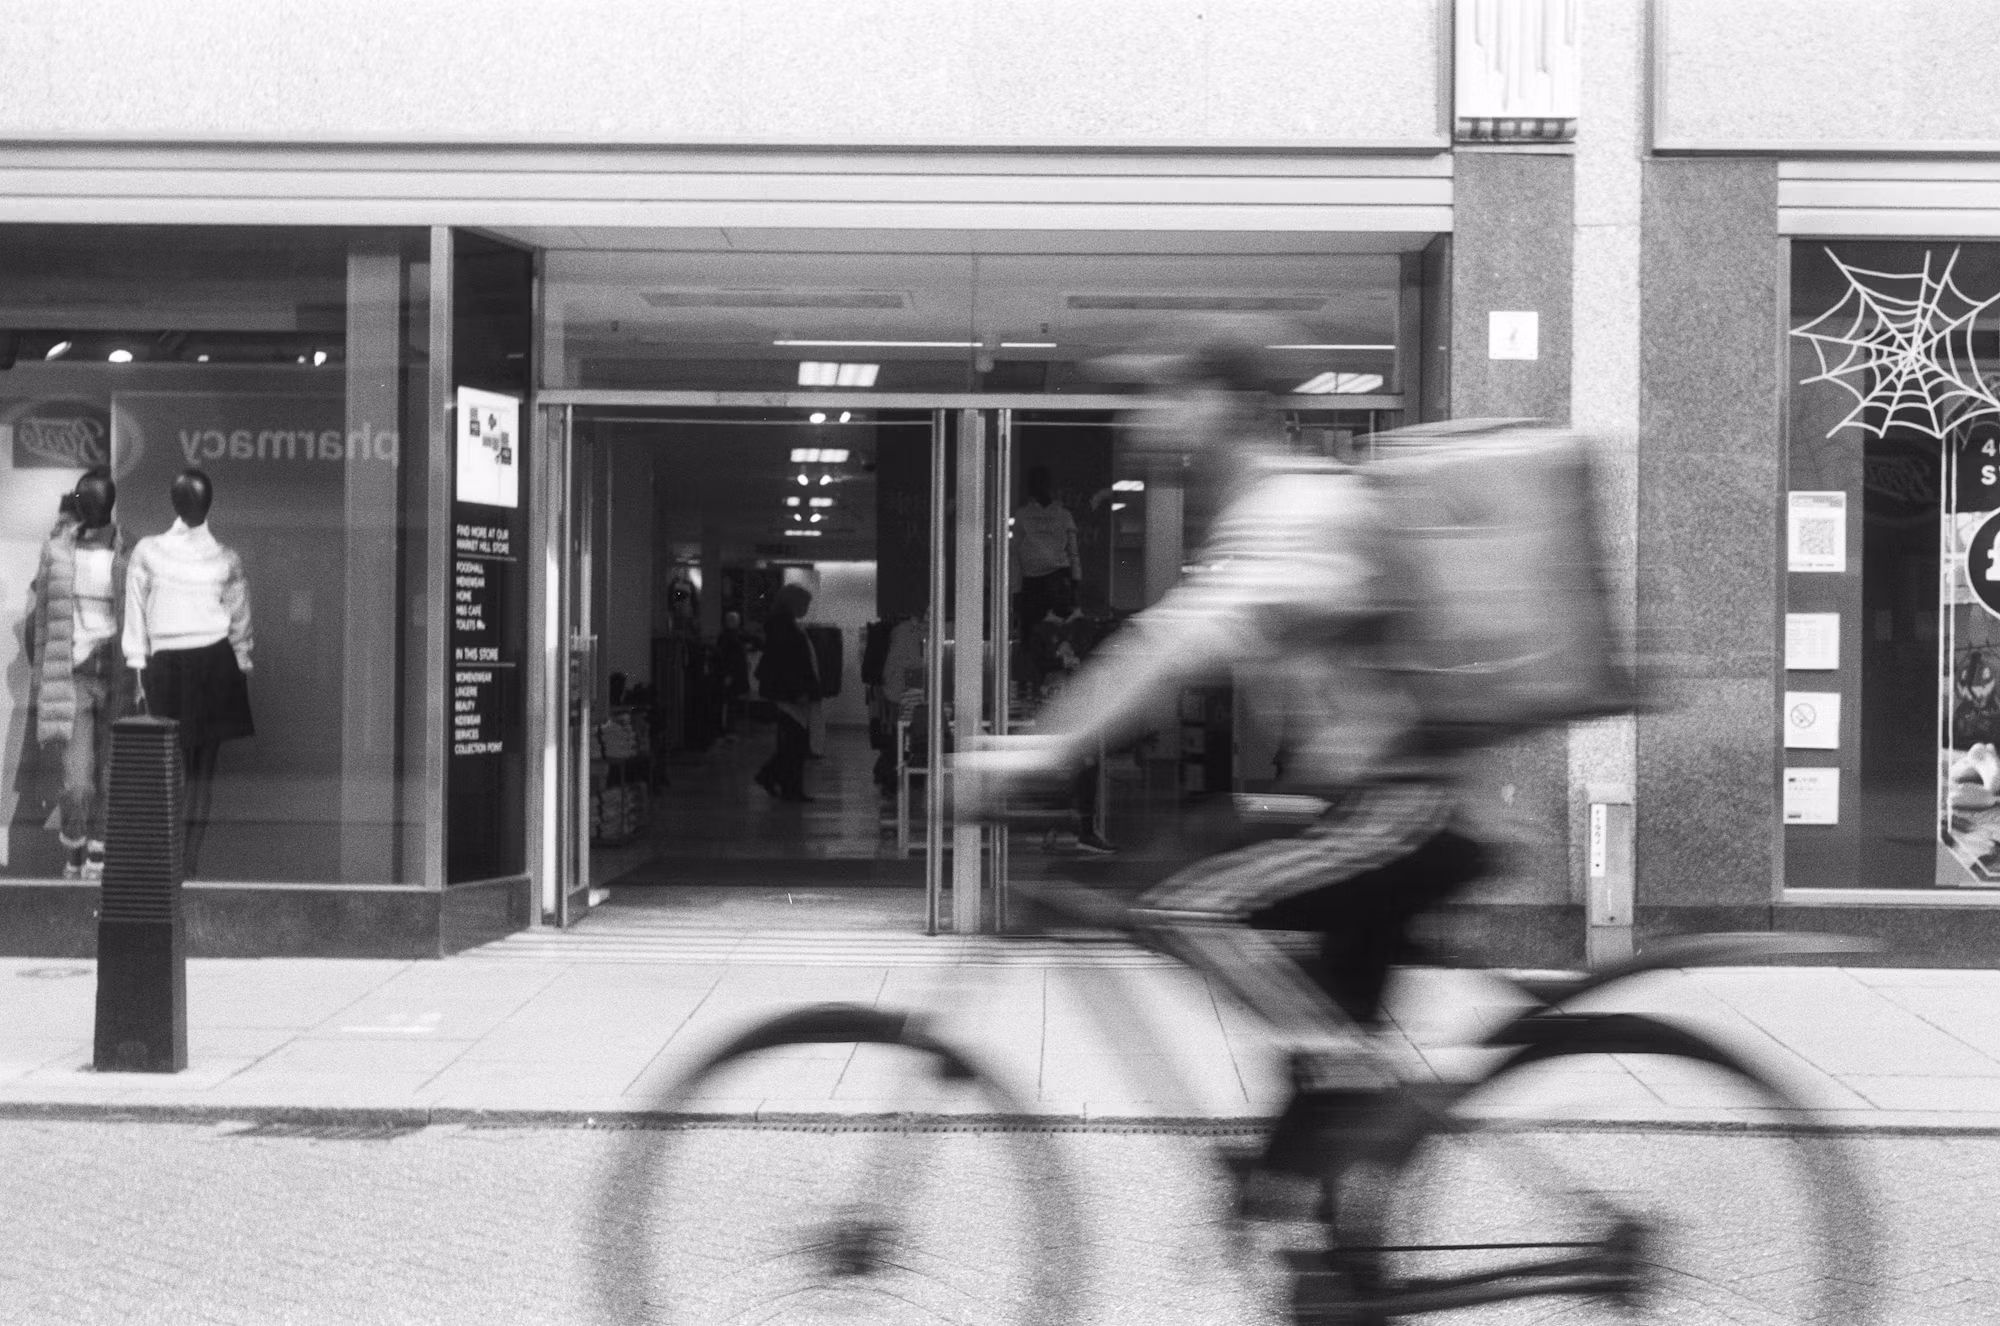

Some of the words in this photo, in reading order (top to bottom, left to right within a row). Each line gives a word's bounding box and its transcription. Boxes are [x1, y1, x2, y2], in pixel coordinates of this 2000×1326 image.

[457, 523, 470, 536] FIND
[471, 526, 487, 539] MORE
[488, 528, 495, 538] AT
[496, 528, 509, 540] OUR
[456, 590, 472, 602] HOME
[456, 648, 463, 660] IN
[464, 647, 478, 661] THIS
[479, 648, 498, 661] STORE
[455, 700, 475, 712] BEAUTY
[455, 742, 487, 755] COLLECTION
[487, 742, 502, 753] POINT
